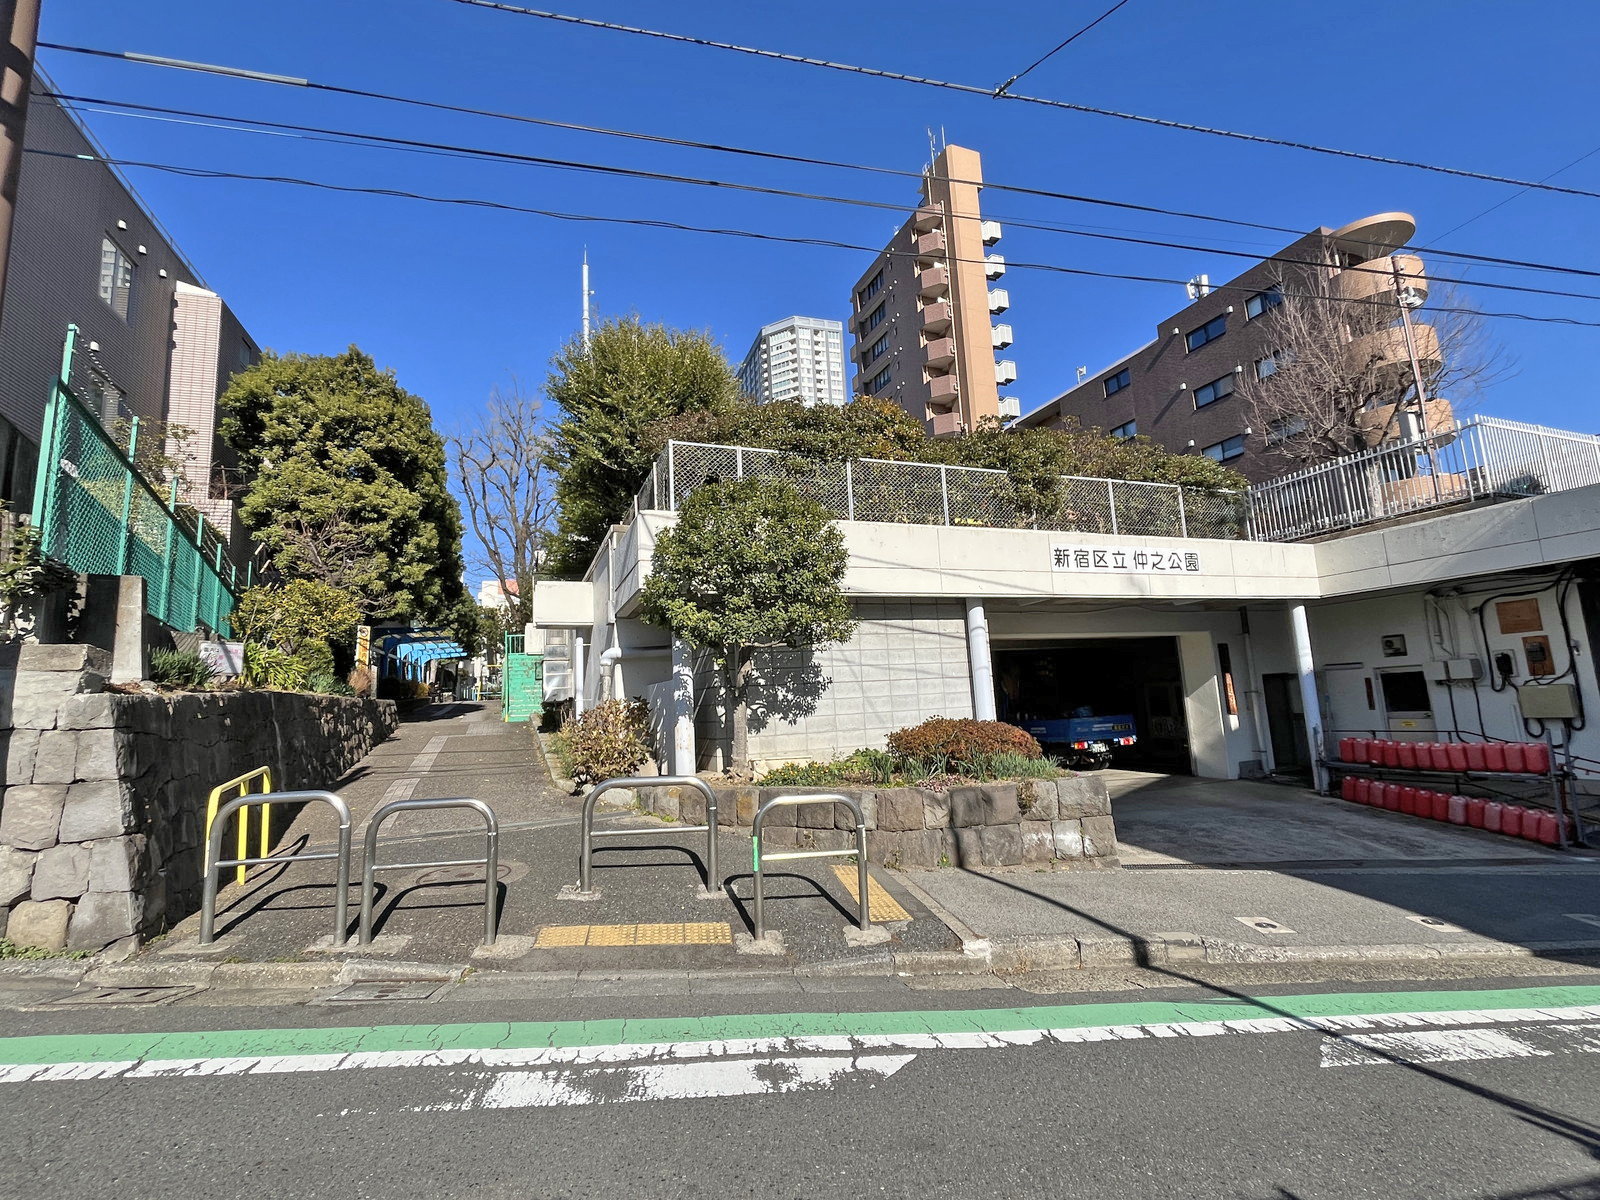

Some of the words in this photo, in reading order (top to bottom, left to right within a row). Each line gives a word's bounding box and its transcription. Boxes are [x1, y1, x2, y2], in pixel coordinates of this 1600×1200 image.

[1053, 547, 1200, 572] 新宿区立仲之公園
